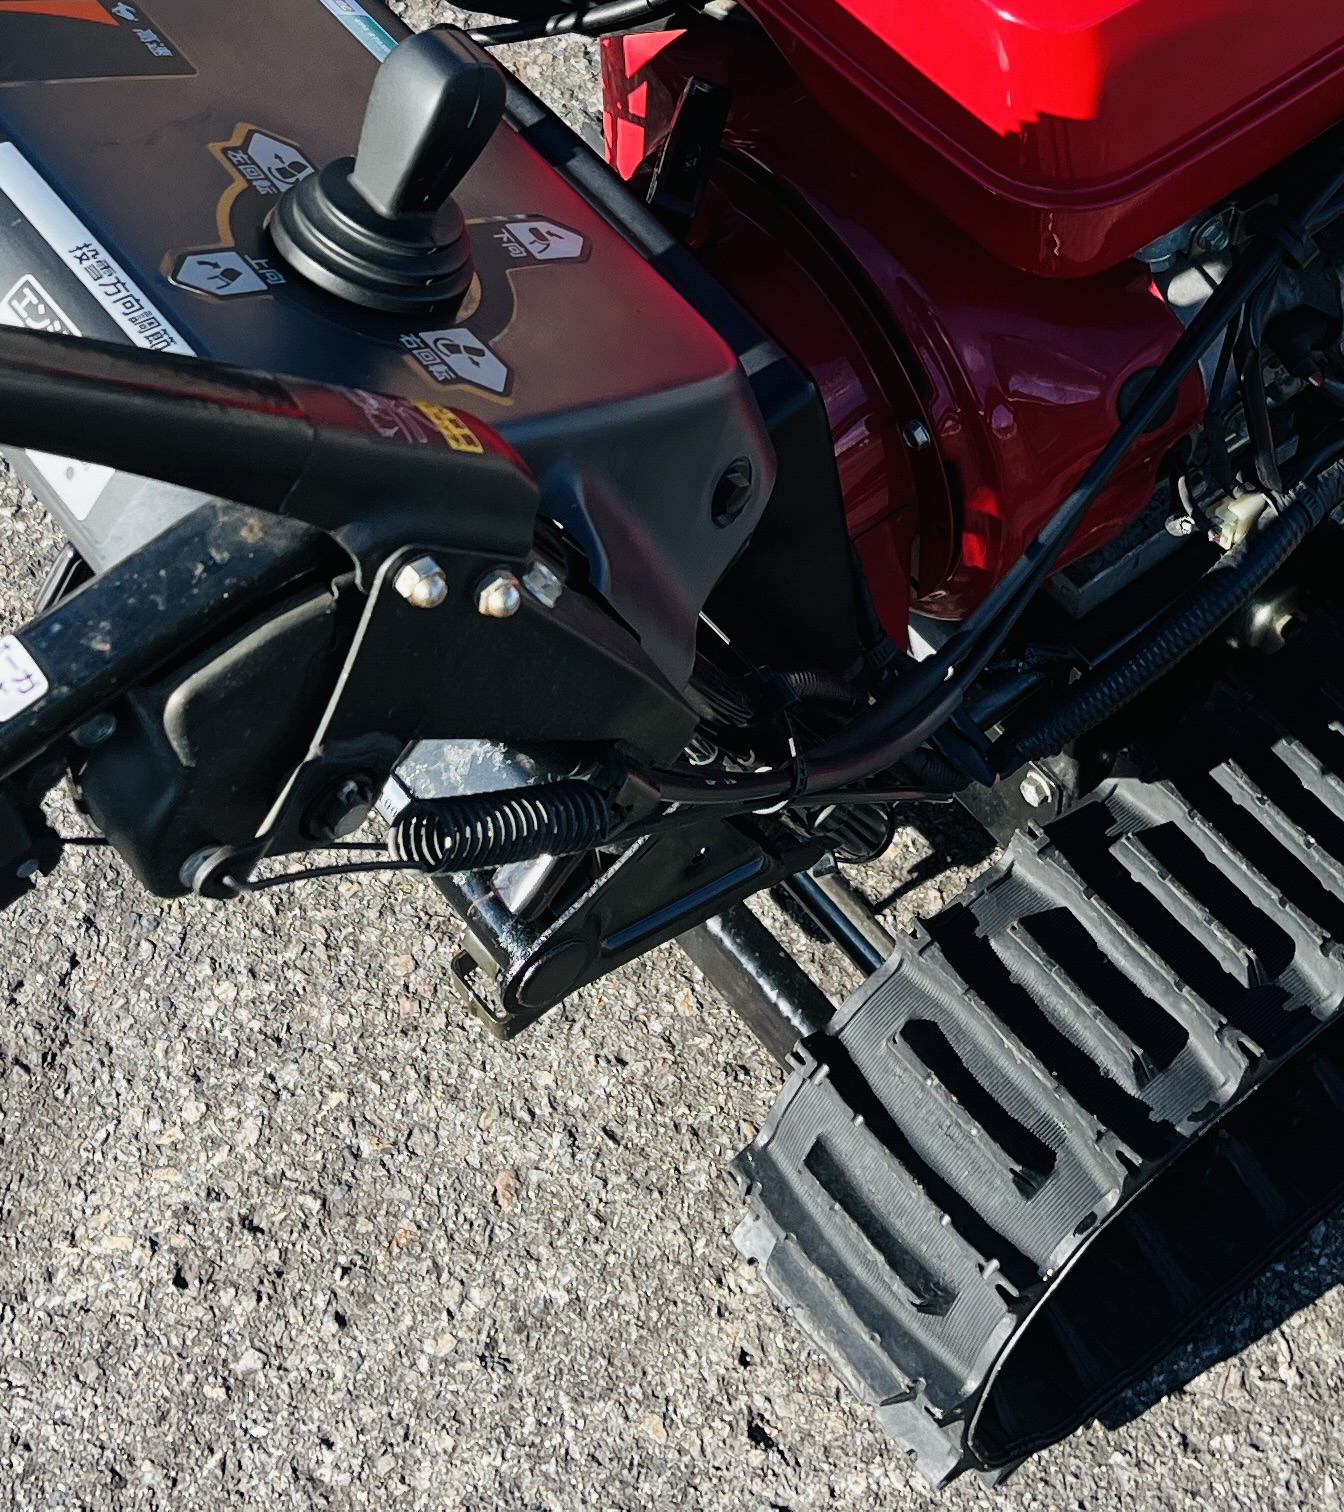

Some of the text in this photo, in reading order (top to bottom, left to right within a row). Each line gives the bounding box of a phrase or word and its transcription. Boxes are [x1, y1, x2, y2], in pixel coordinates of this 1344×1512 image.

[227, 150, 278, 195] 左回転
[493, 228, 527, 257] 下向
[244, 254, 287, 284] 上向
[68, 242, 178, 351] 投雪方向調節
[400, 333, 456, 381] 右回転
